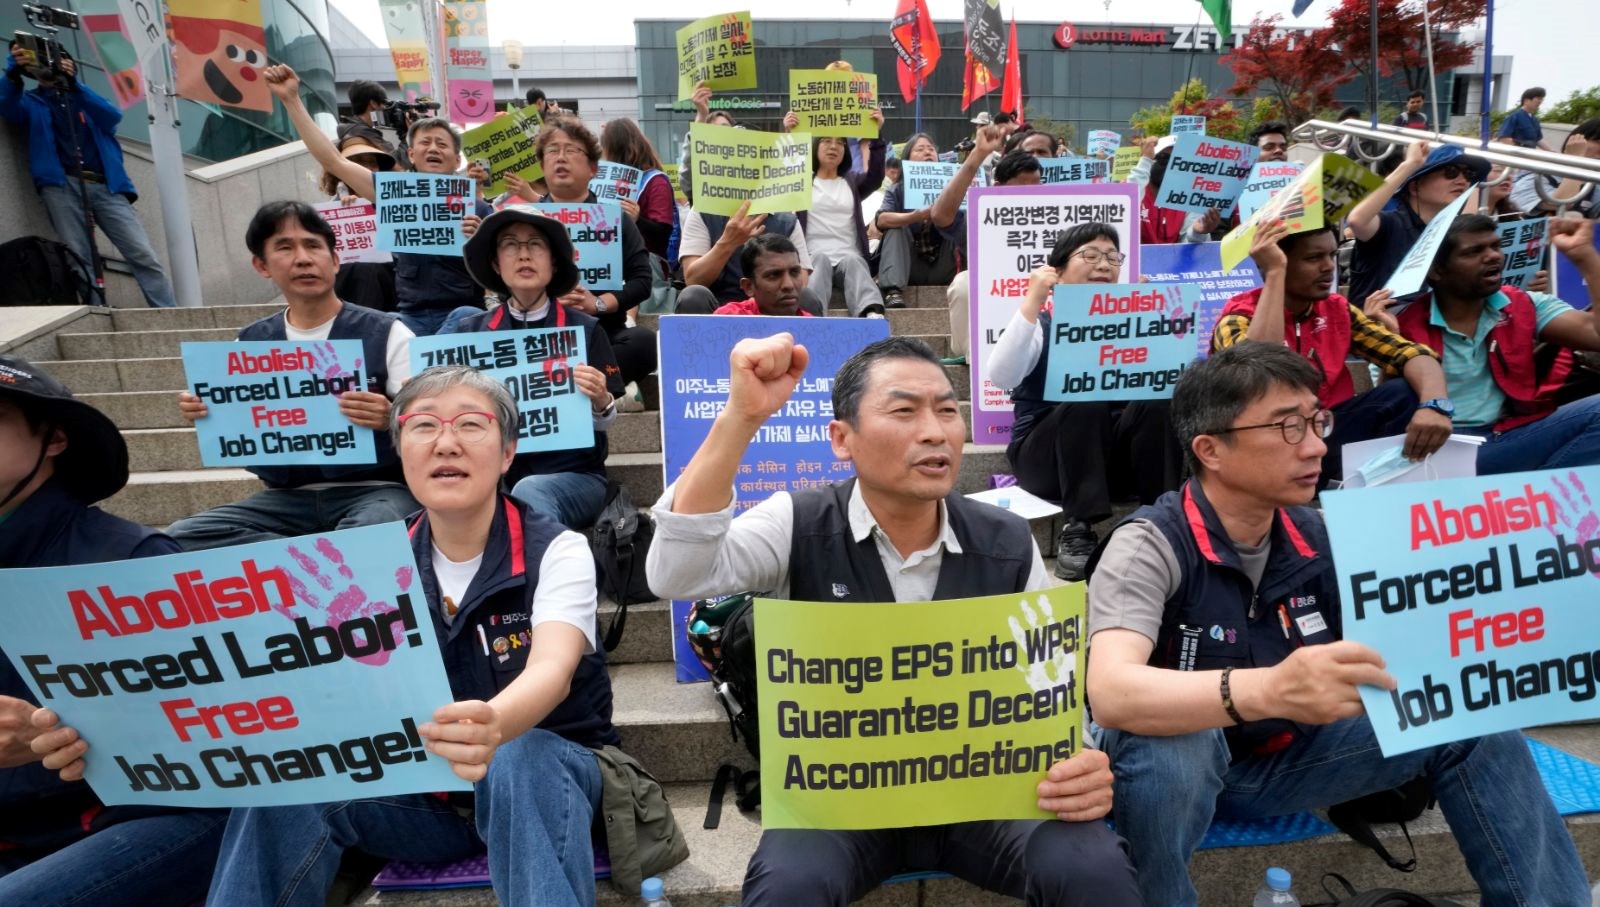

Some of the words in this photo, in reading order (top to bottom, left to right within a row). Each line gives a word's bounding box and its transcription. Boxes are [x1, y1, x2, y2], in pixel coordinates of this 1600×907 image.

[1082, 30, 1126, 42] LOTTE
[1130, 29, 1166, 43] Mart
[449, 48, 482, 58] Super
[719, 43, 728, 58] 수
[798, 81, 846, 96] 노동허가제
[791, 97, 831, 112] 인간답게
[833, 96, 843, 111] 살
[846, 96, 856, 110] 수
[808, 113, 837, 128] 기숙사
[463, 138, 492, 158] Change
[490, 130, 506, 146] EPS
[505, 124, 521, 139] into
[695, 140, 735, 160] Change
[737, 144, 757, 159] EPS
[759, 145, 780, 159] into
[782, 143, 808, 158] WPS!
[1195, 142, 1243, 162] Abolish
[699, 160, 760, 180] Guarantee
[763, 162, 805, 179] Decent
[1169, 156, 1217, 176] Forced
[380, 180, 431, 200] 강제노동
[435, 178, 471, 198] 철폐!
[701, 178, 805, 200] Accommodations!
[1192, 176, 1223, 192] Free
[1243, 178, 1286, 192] orced
[1165, 189, 1186, 205] Job
[380, 204, 418, 225] 사업장
[422, 202, 466, 222] 이동의
[984, 205, 1060, 226] 사업장변경
[1064, 203, 1126, 224] 지역제한
[346, 236, 374, 250] 보장!
[393, 227, 455, 247] 자유보장!
[1007, 230, 1038, 249] 즉각
[1088, 289, 1165, 316] Abolish
[1055, 318, 1131, 344] Forced
[1136, 311, 1196, 338] Labor!
[523, 329, 579, 364] 철폐!
[1099, 345, 1148, 366] Free
[227, 347, 315, 375] Abolish
[194, 376, 280, 404] Forced
[284, 370, 362, 399] Labor!
[1061, 371, 1096, 394] Job
[251, 406, 307, 428] Free
[786, 400, 815, 418] 자유
[219, 433, 257, 458] Job
[261, 425, 356, 456] Change!
[1410, 484, 1557, 551] Abolish
[1350, 546, 1502, 620] Forced
[66, 558, 296, 641] Abolish
[1448, 607, 1545, 658] Free
[21, 636, 224, 699] Forced
[223, 593, 423, 680] Labor!
[766, 648, 883, 694] Change
[891, 641, 954, 681] EPS
[961, 635, 1018, 674] into
[1025, 614, 1080, 664] WPS!
[777, 696, 958, 738] Guarantee
[967, 670, 1077, 729] Decent
[1390, 674, 1453, 732] Job
[160, 695, 299, 742] Free
[113, 753, 200, 792] Job
[200, 717, 428, 783] Change!
[784, 726, 1076, 790] Accommodations!
